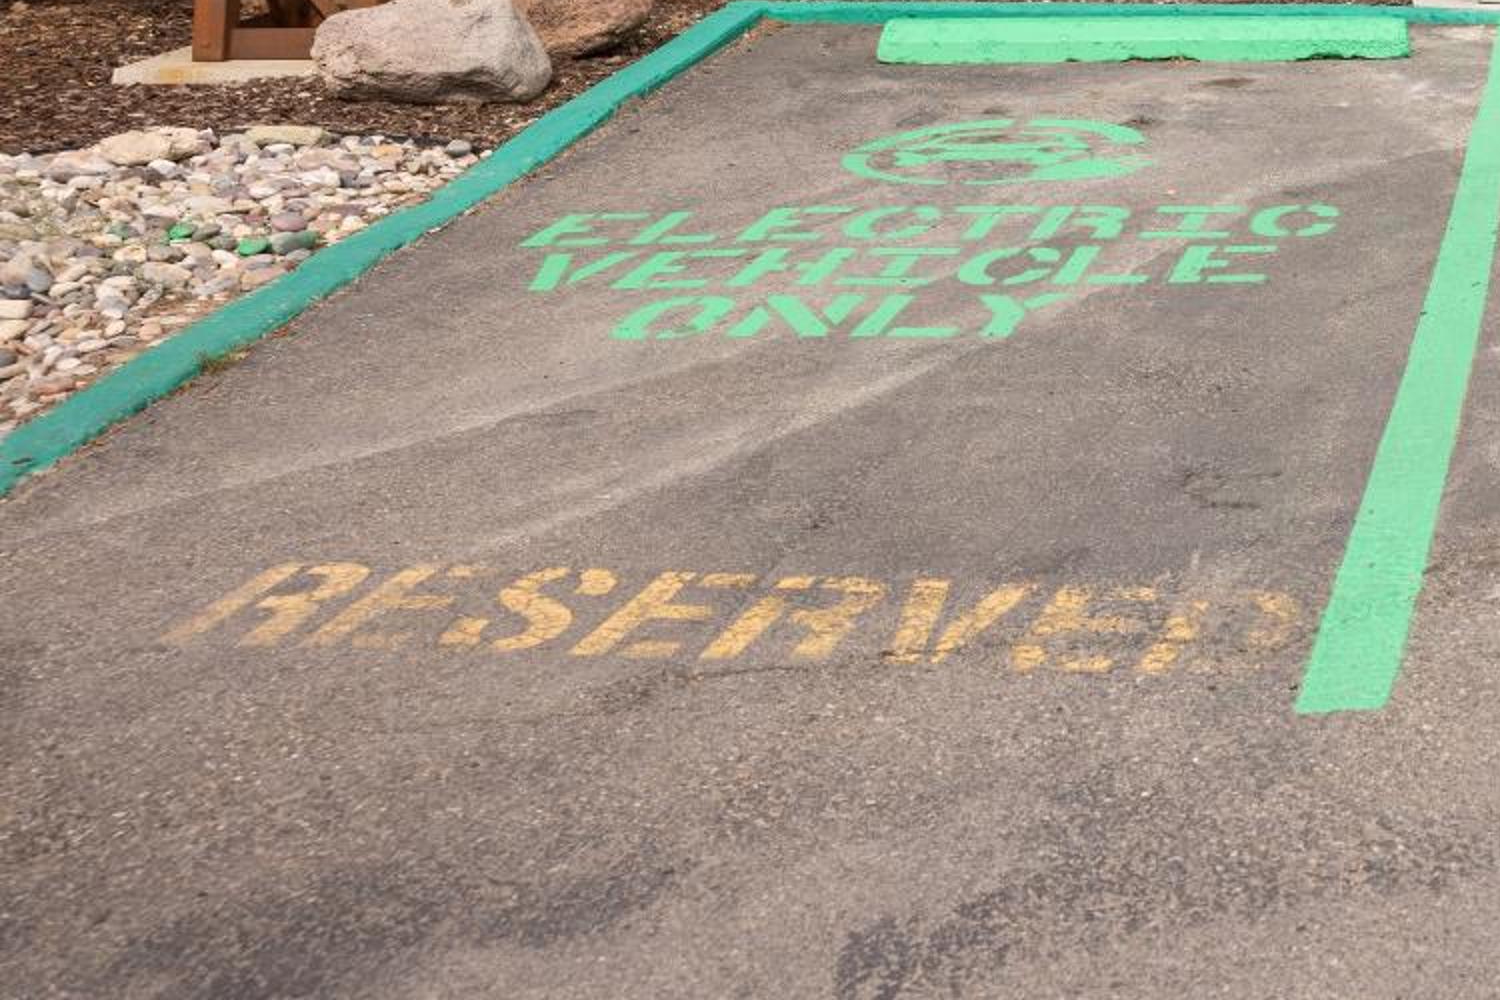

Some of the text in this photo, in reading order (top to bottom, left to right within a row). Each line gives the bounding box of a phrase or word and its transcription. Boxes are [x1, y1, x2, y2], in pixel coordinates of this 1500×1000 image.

[519, 204, 1339, 248] ELECTRIC
[526, 246, 1279, 292] VEHICLE
[609, 293, 1084, 341] ONLY
